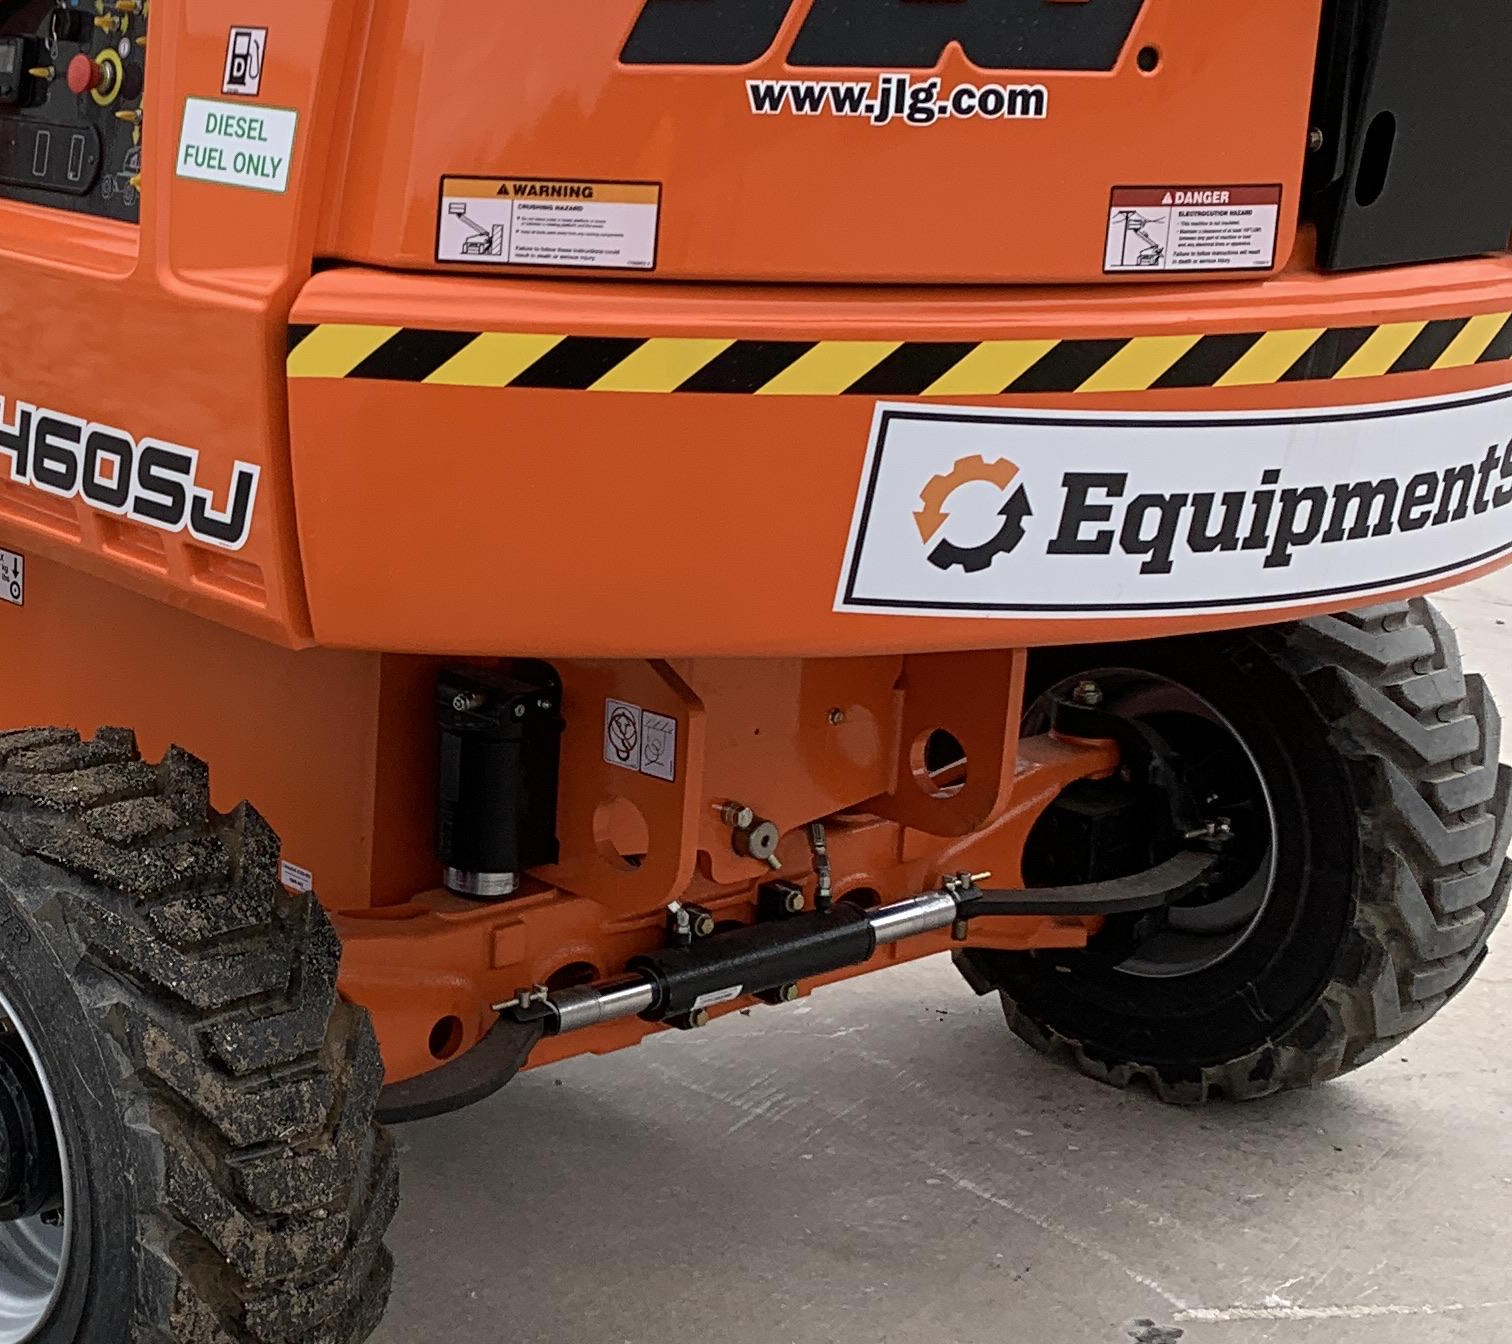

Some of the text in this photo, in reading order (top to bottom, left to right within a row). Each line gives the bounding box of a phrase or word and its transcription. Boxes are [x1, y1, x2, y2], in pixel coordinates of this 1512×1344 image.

[750, 78, 1045, 122] www.jlg.com
[205, 112, 268, 142] DIESEL
[184, 144, 282, 179] FUEL ONLY
[513, 184, 594, 198] WARNING
[1174, 191, 1230, 205] DANGER
